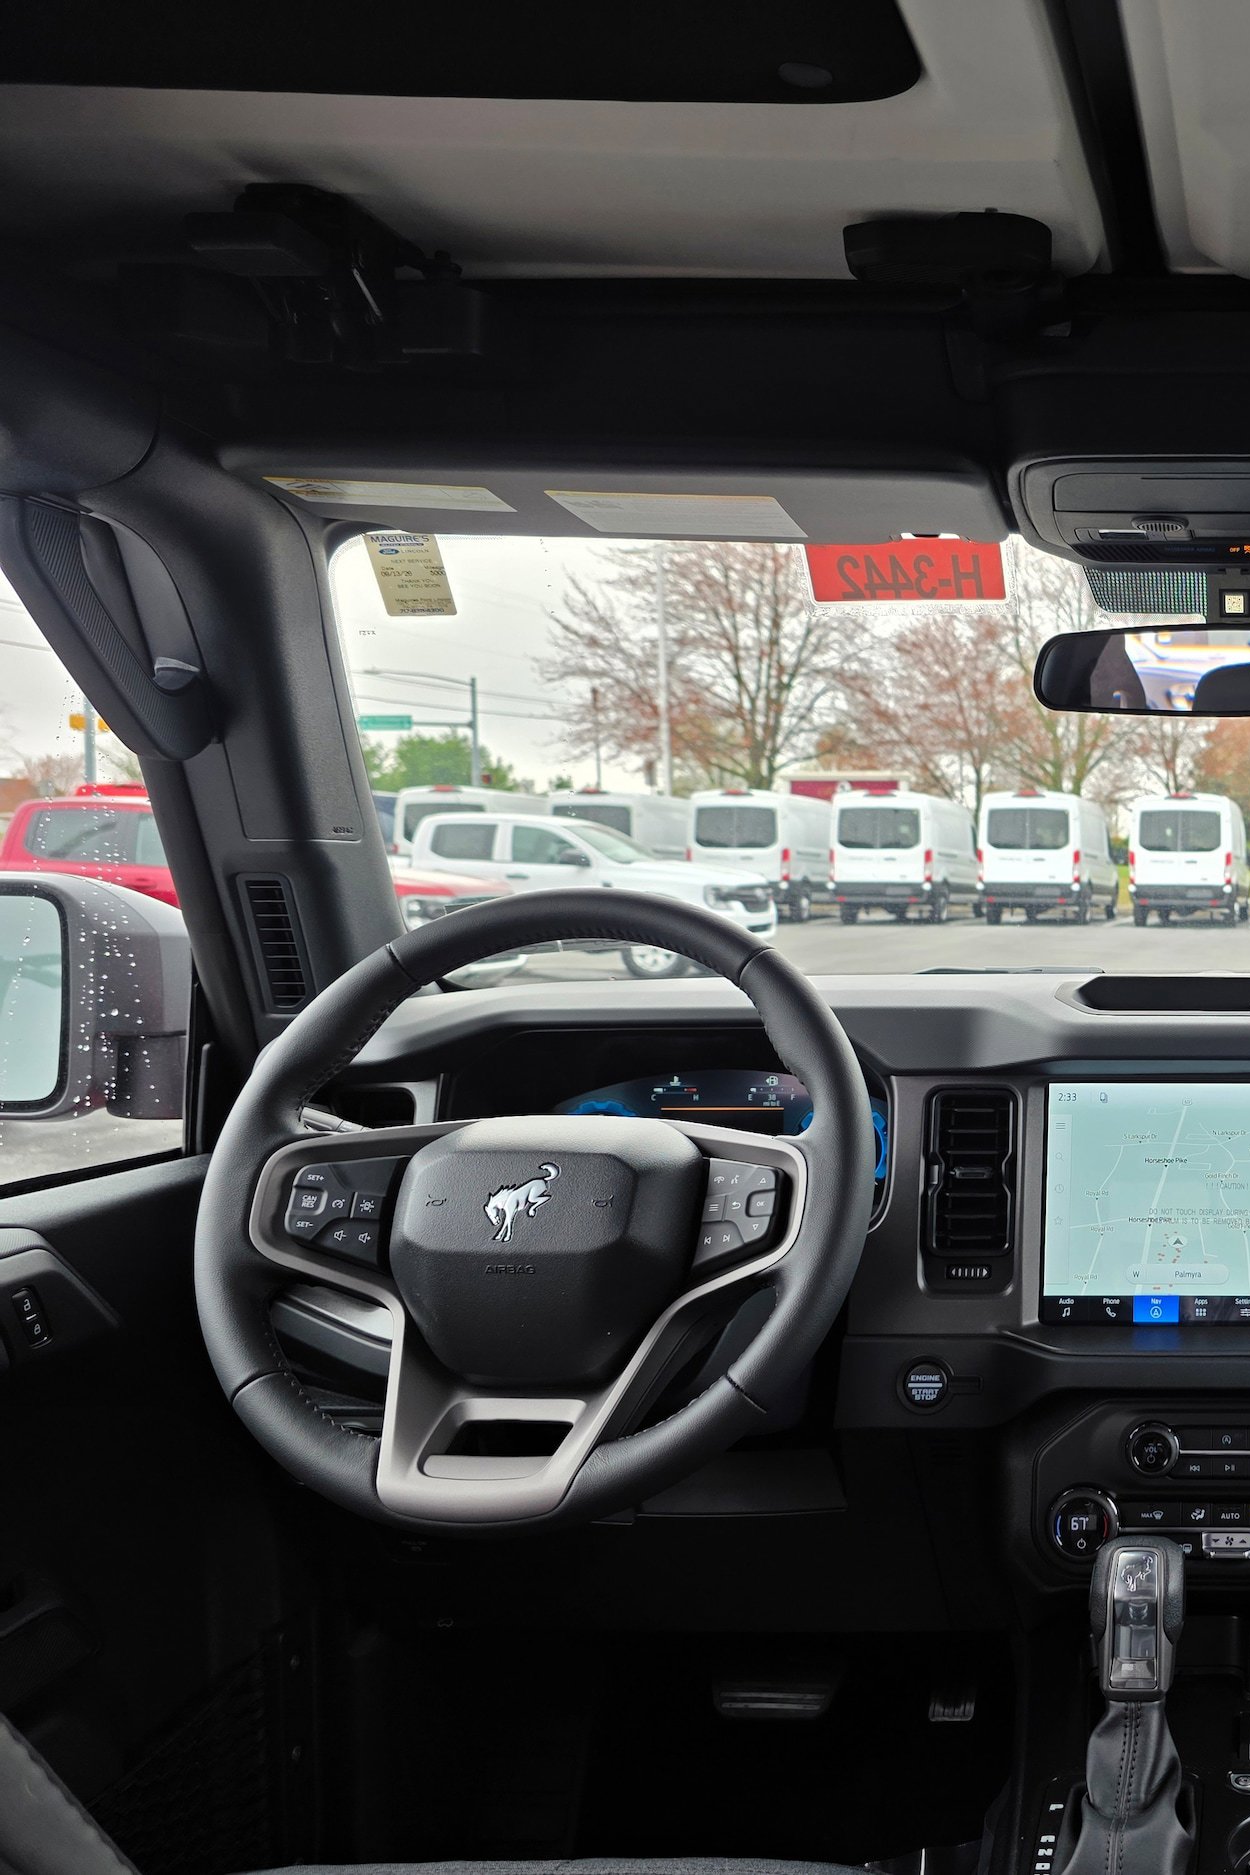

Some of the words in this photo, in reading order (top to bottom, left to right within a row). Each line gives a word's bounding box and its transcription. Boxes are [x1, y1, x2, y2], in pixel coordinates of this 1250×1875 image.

[370, 535, 430, 543] MAGUIRE'S
[1058, 1092, 1077, 1102] 2:33
[1128, 1133, 1150, 1141] Larkspur
[301, 1200, 315, 1208] RES
[1199, 1208, 1223, 1216] DISPLAY
[484, 1264, 536, 1274] AIRBAG
[1174, 1270, 1202, 1279] Palmyra
[1194, 1298, 1208, 1306] Apps
[1049, 1803, 1064, 1811] P
[1040, 1835, 1056, 1843] R
[1037, 1848, 1053, 1856] N
[1035, 1862, 1051, 1871] D
